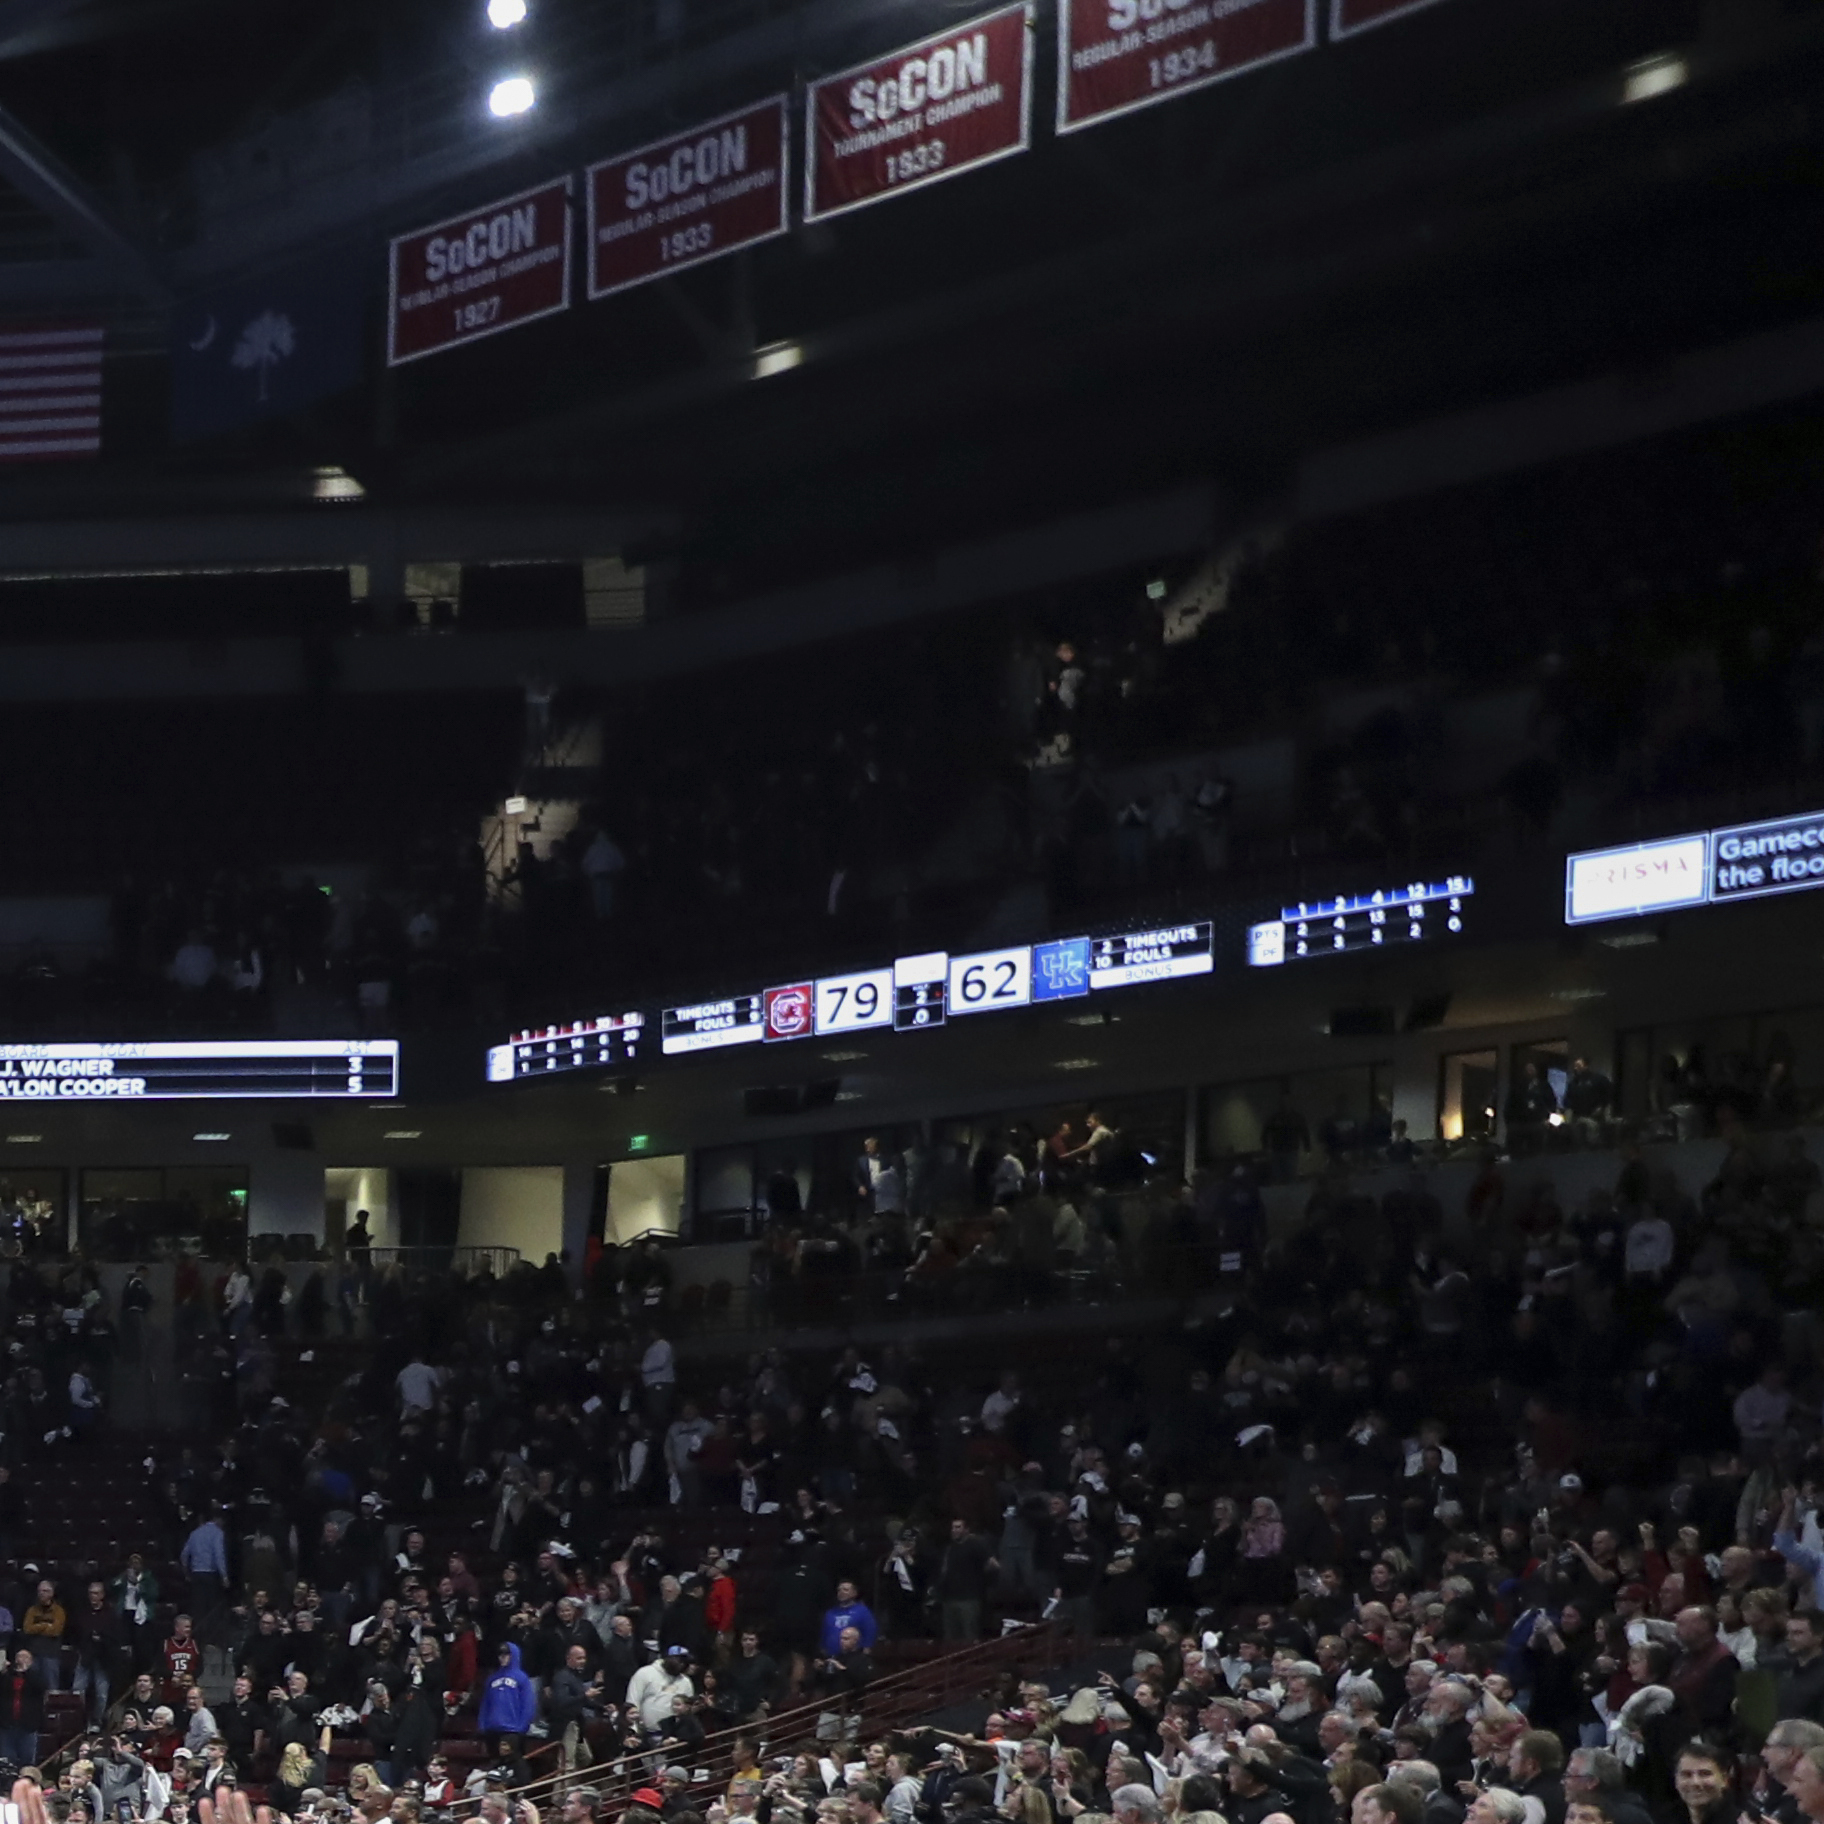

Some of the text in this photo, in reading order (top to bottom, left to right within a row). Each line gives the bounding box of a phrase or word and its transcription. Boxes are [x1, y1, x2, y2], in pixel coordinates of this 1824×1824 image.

[849, 32, 987, 129] SoCON
[1149, 39, 1216, 89] 1934
[925, 82, 1002, 128] CHAMPION
[625, 124, 747, 211] SoCON
[886, 138, 946, 184] 1933
[426, 203, 537, 282] SoCON
[660, 221, 712, 261] 1933
[455, 296, 502, 332] 1927
[1718, 866, 1764, 889] the
[1095, 945, 1172, 969] 10 FOULS
[1101, 927, 1198, 954] 2 TIMEOUTS
[960, 959, 1017, 1003] 62
[1125, 964, 1172, 980] BONUS
[675, 1002, 736, 1021] TIMEOUTS
[826, 981, 879, 1024] 79
[915, 991, 928, 1005] 2
[695, 1011, 759, 1032] FOULS 9
[20, 1059, 114, 1077] WAGNER
[348, 1056, 362, 1073] 3
[59, 1078, 146, 1096] COOPER
[348, 1076, 362, 1093] 5
